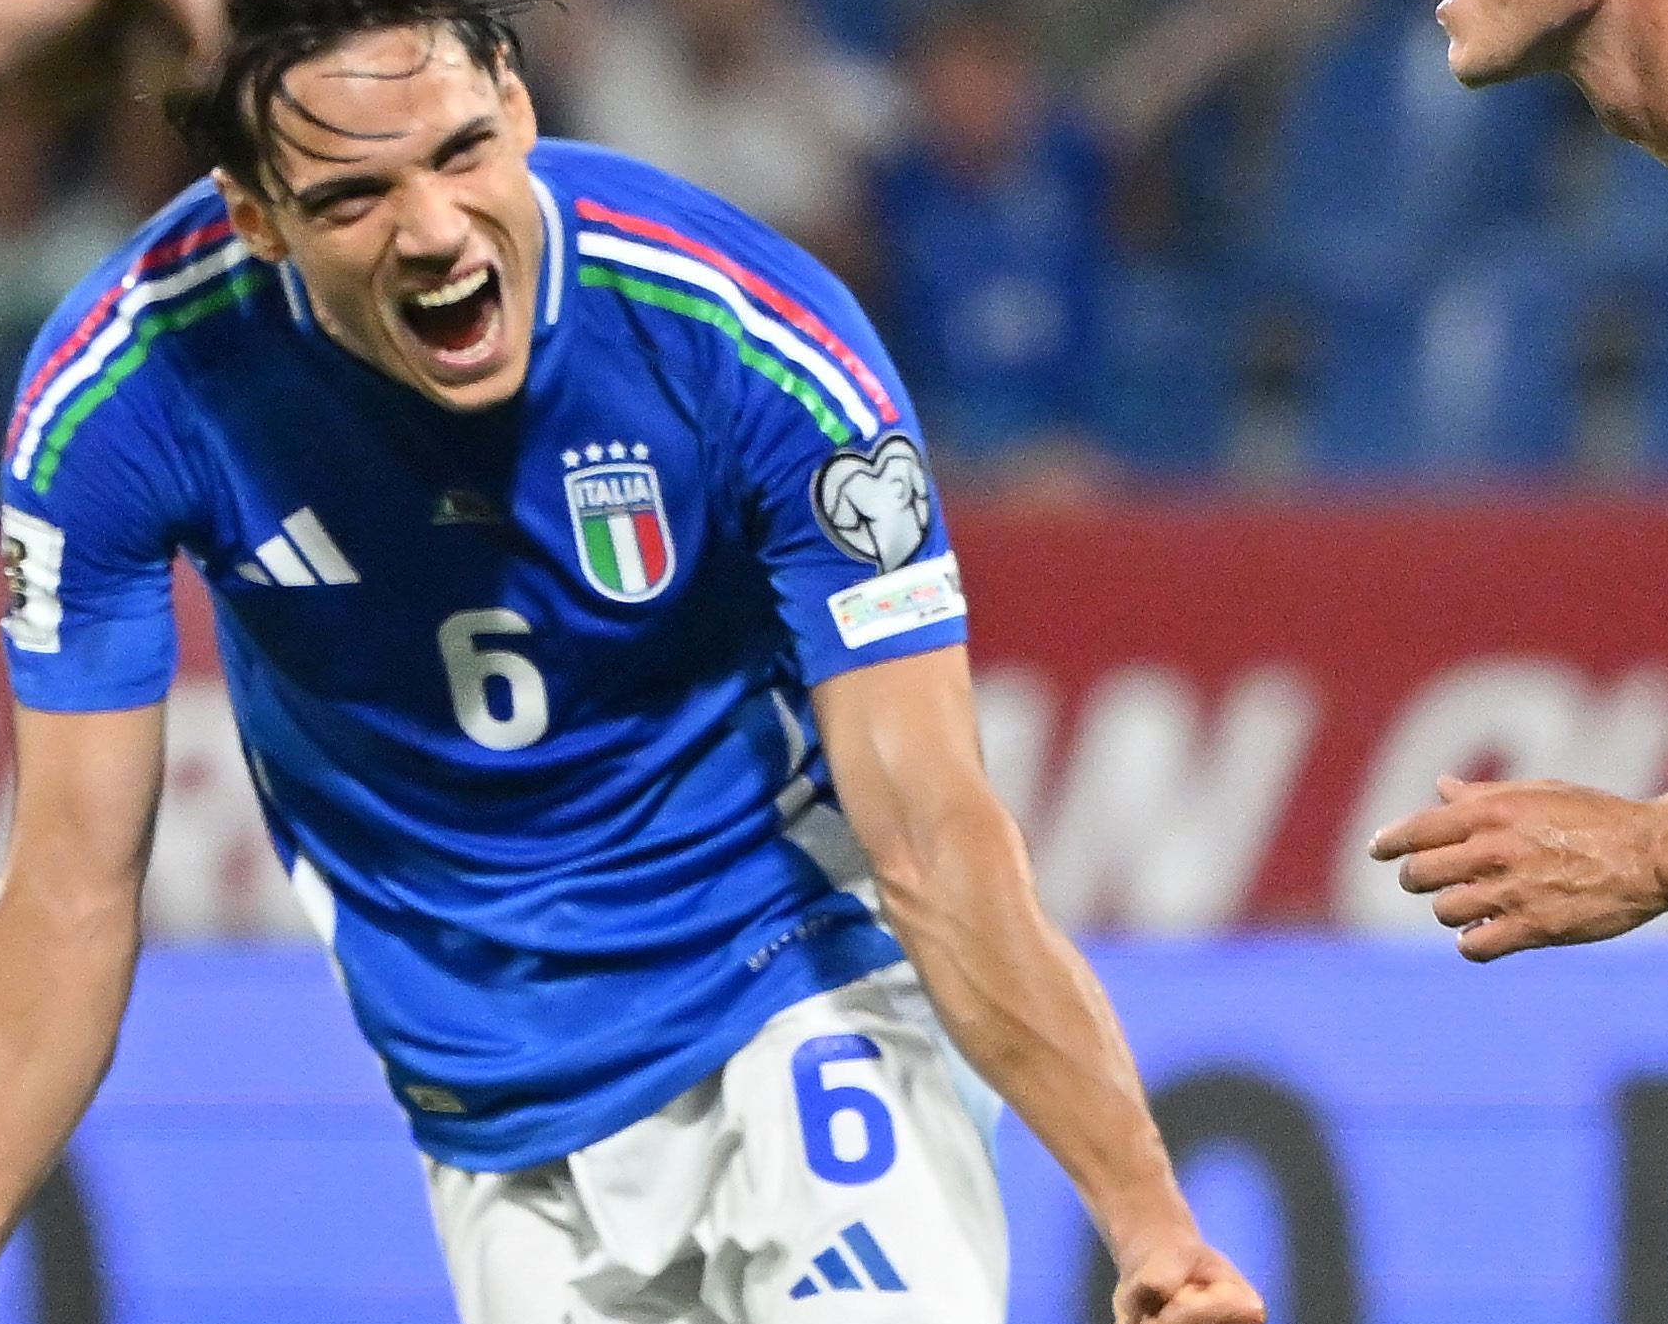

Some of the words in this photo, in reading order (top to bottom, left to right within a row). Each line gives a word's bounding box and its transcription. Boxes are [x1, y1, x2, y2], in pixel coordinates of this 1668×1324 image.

[574, 476, 652, 509] ITALIA
[437, 606, 549, 752] 6
[790, 1033, 898, 1187] 6
